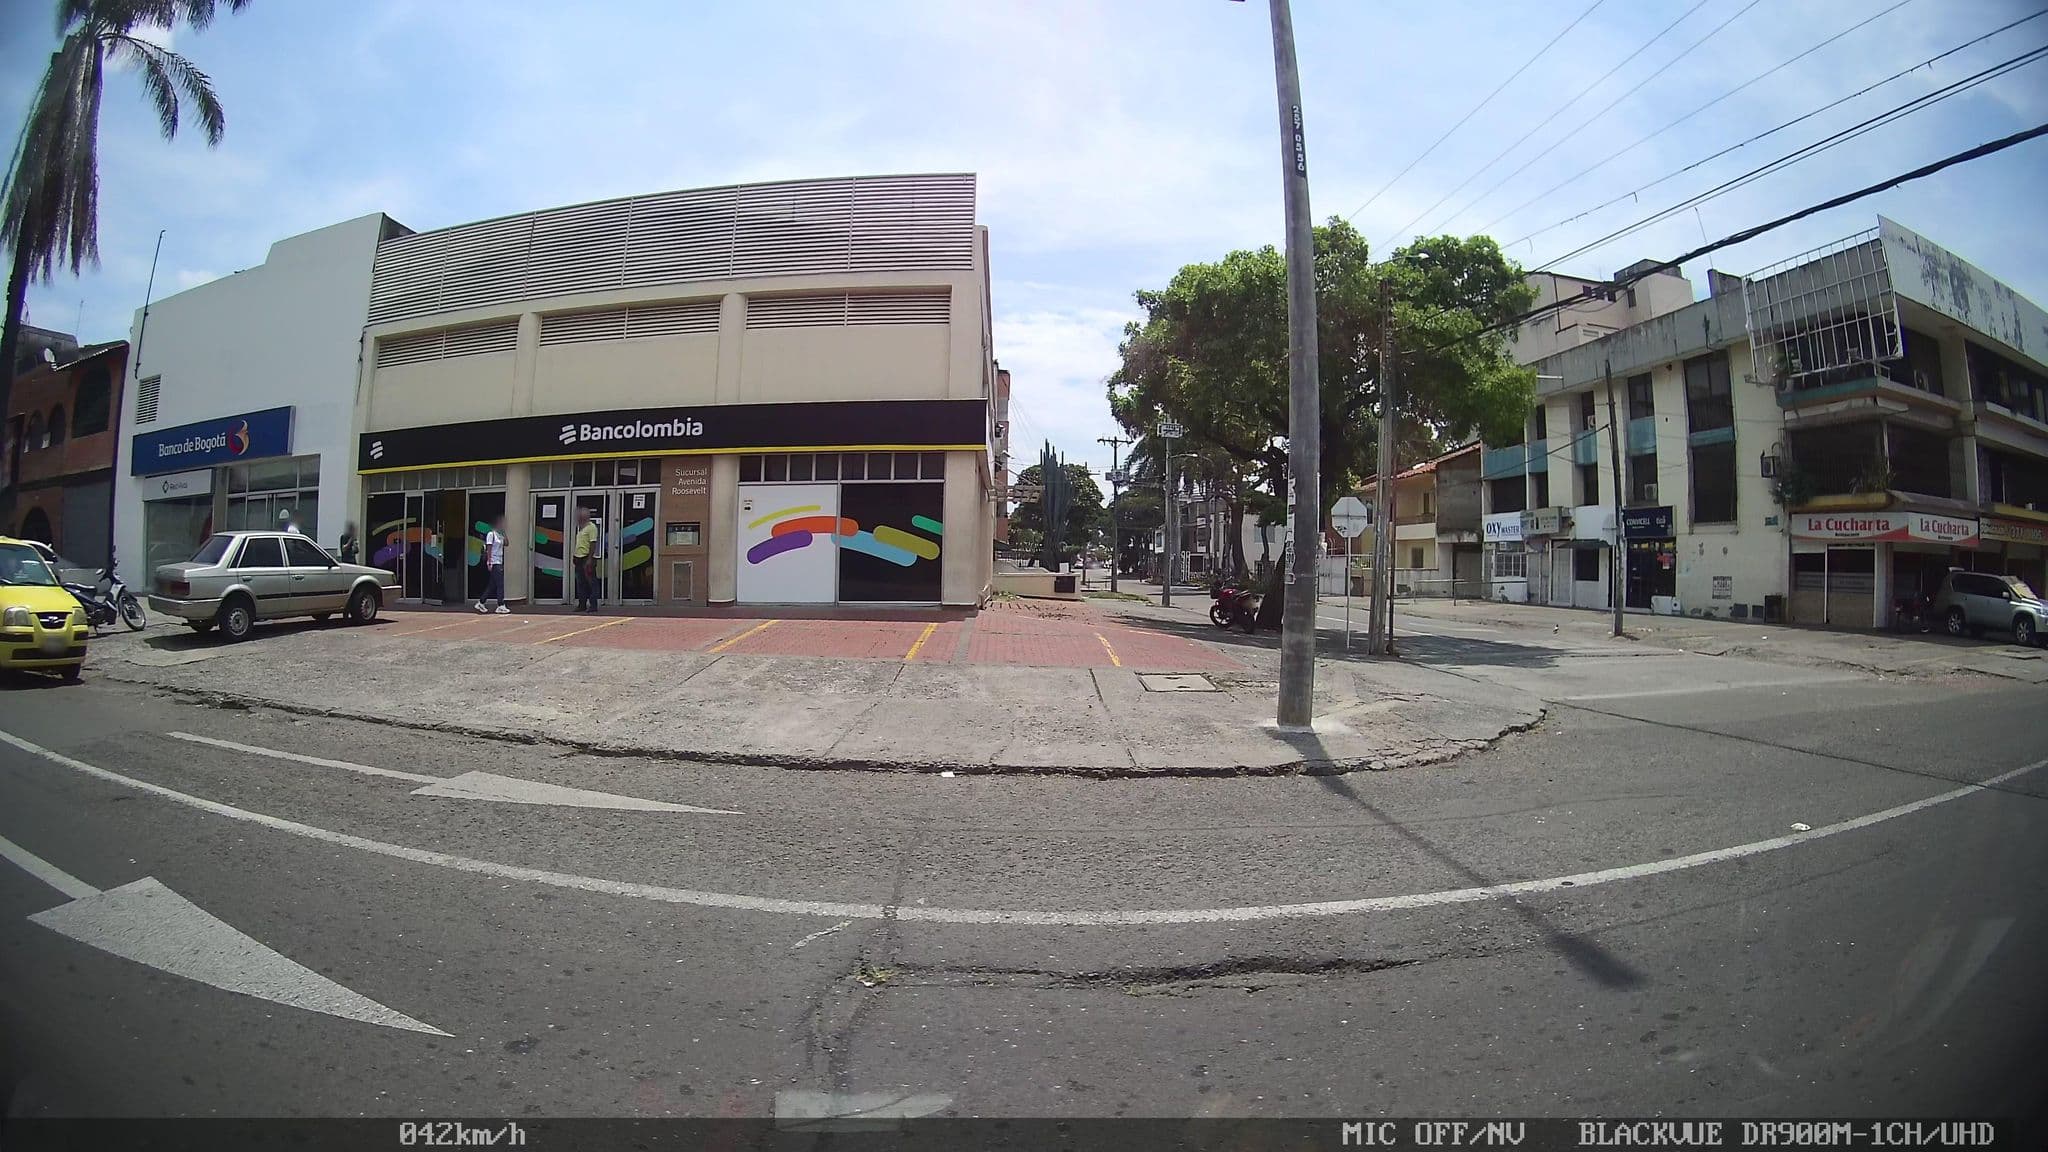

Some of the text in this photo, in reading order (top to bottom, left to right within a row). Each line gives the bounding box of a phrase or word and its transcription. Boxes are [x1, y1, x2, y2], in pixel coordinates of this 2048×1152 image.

[580, 417, 703, 441] Bancolombia
[159, 432, 226, 457] Banco de Bogotá
[675, 468, 707, 476] Sucursal
[672, 487, 706, 495] Roosevelt
[1486, 521, 1501, 537] OXY
[1808, 518, 1822, 531] La
[1920, 517, 1930, 532] La
